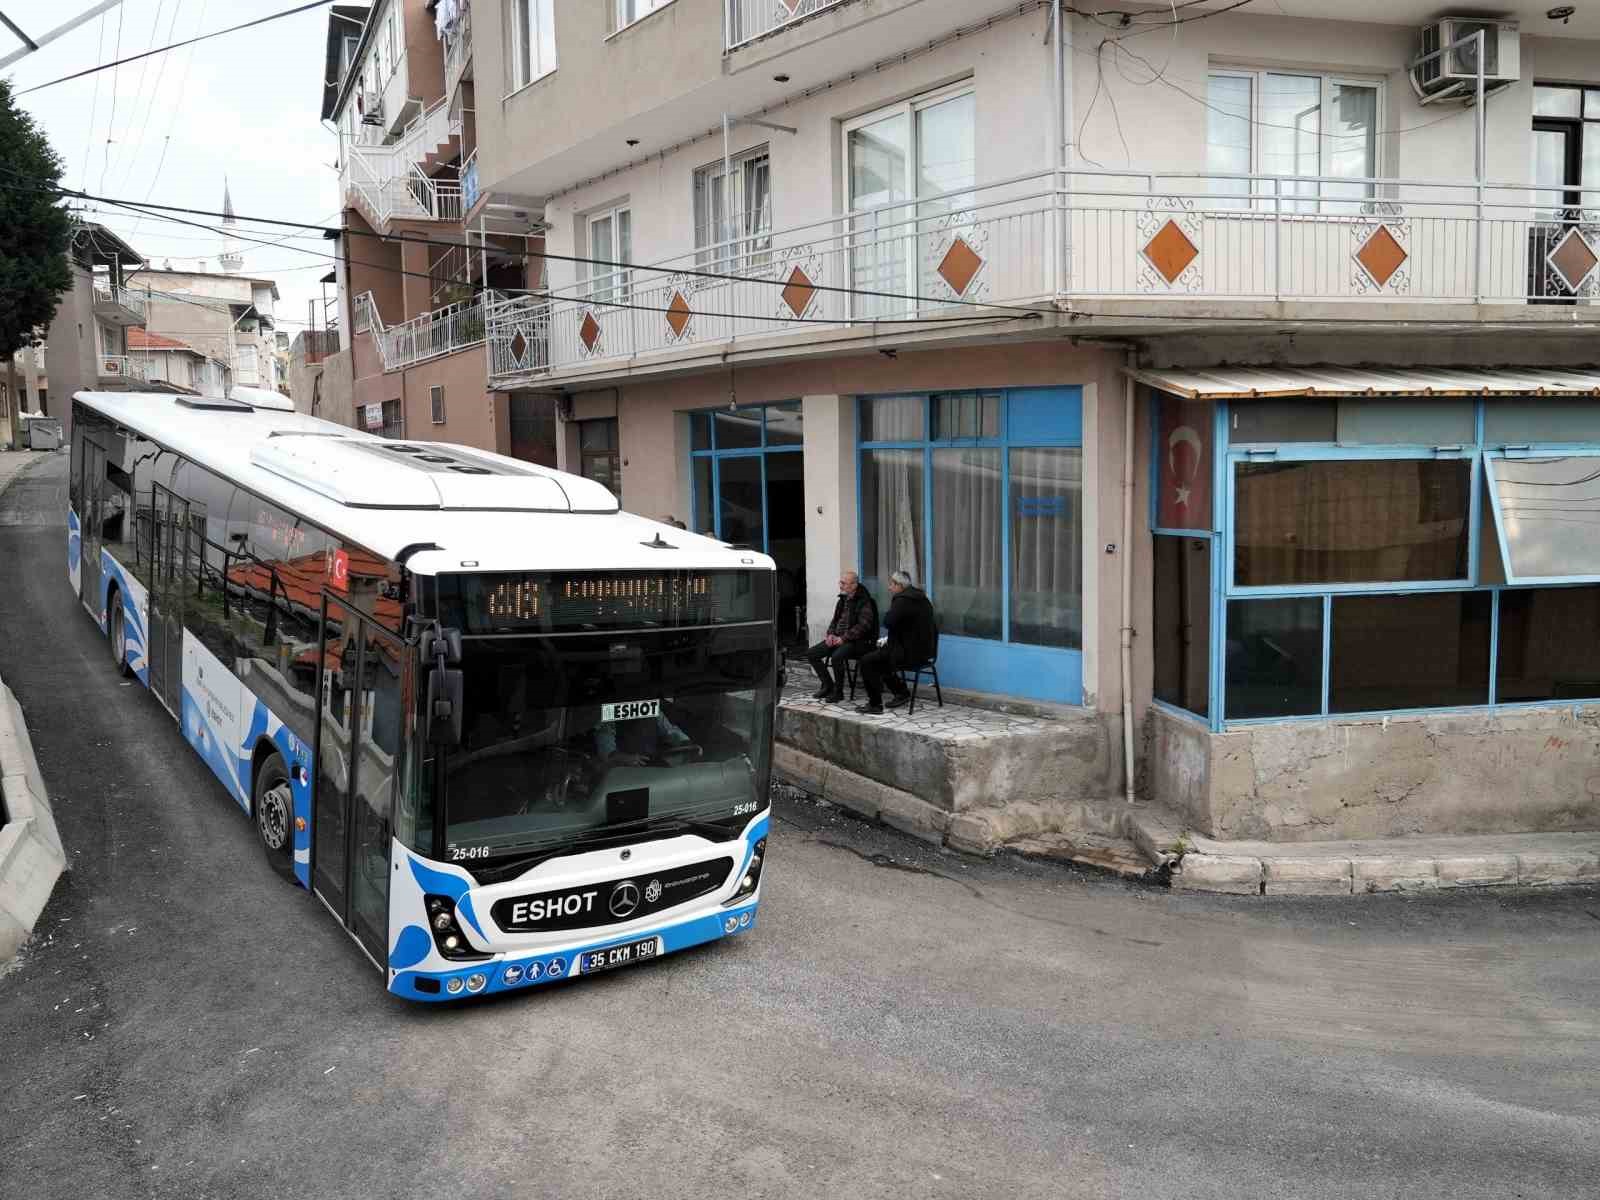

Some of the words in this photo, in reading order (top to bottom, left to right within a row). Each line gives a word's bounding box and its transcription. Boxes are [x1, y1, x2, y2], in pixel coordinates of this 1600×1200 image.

[614, 702, 657, 718] ESHOT
[733, 801, 757, 816] 25-016
[452, 846, 489, 860] 25-016
[512, 891, 598, 923] ESHOT
[590, 953, 605, 968] 35
[636, 941, 655, 957] 190
